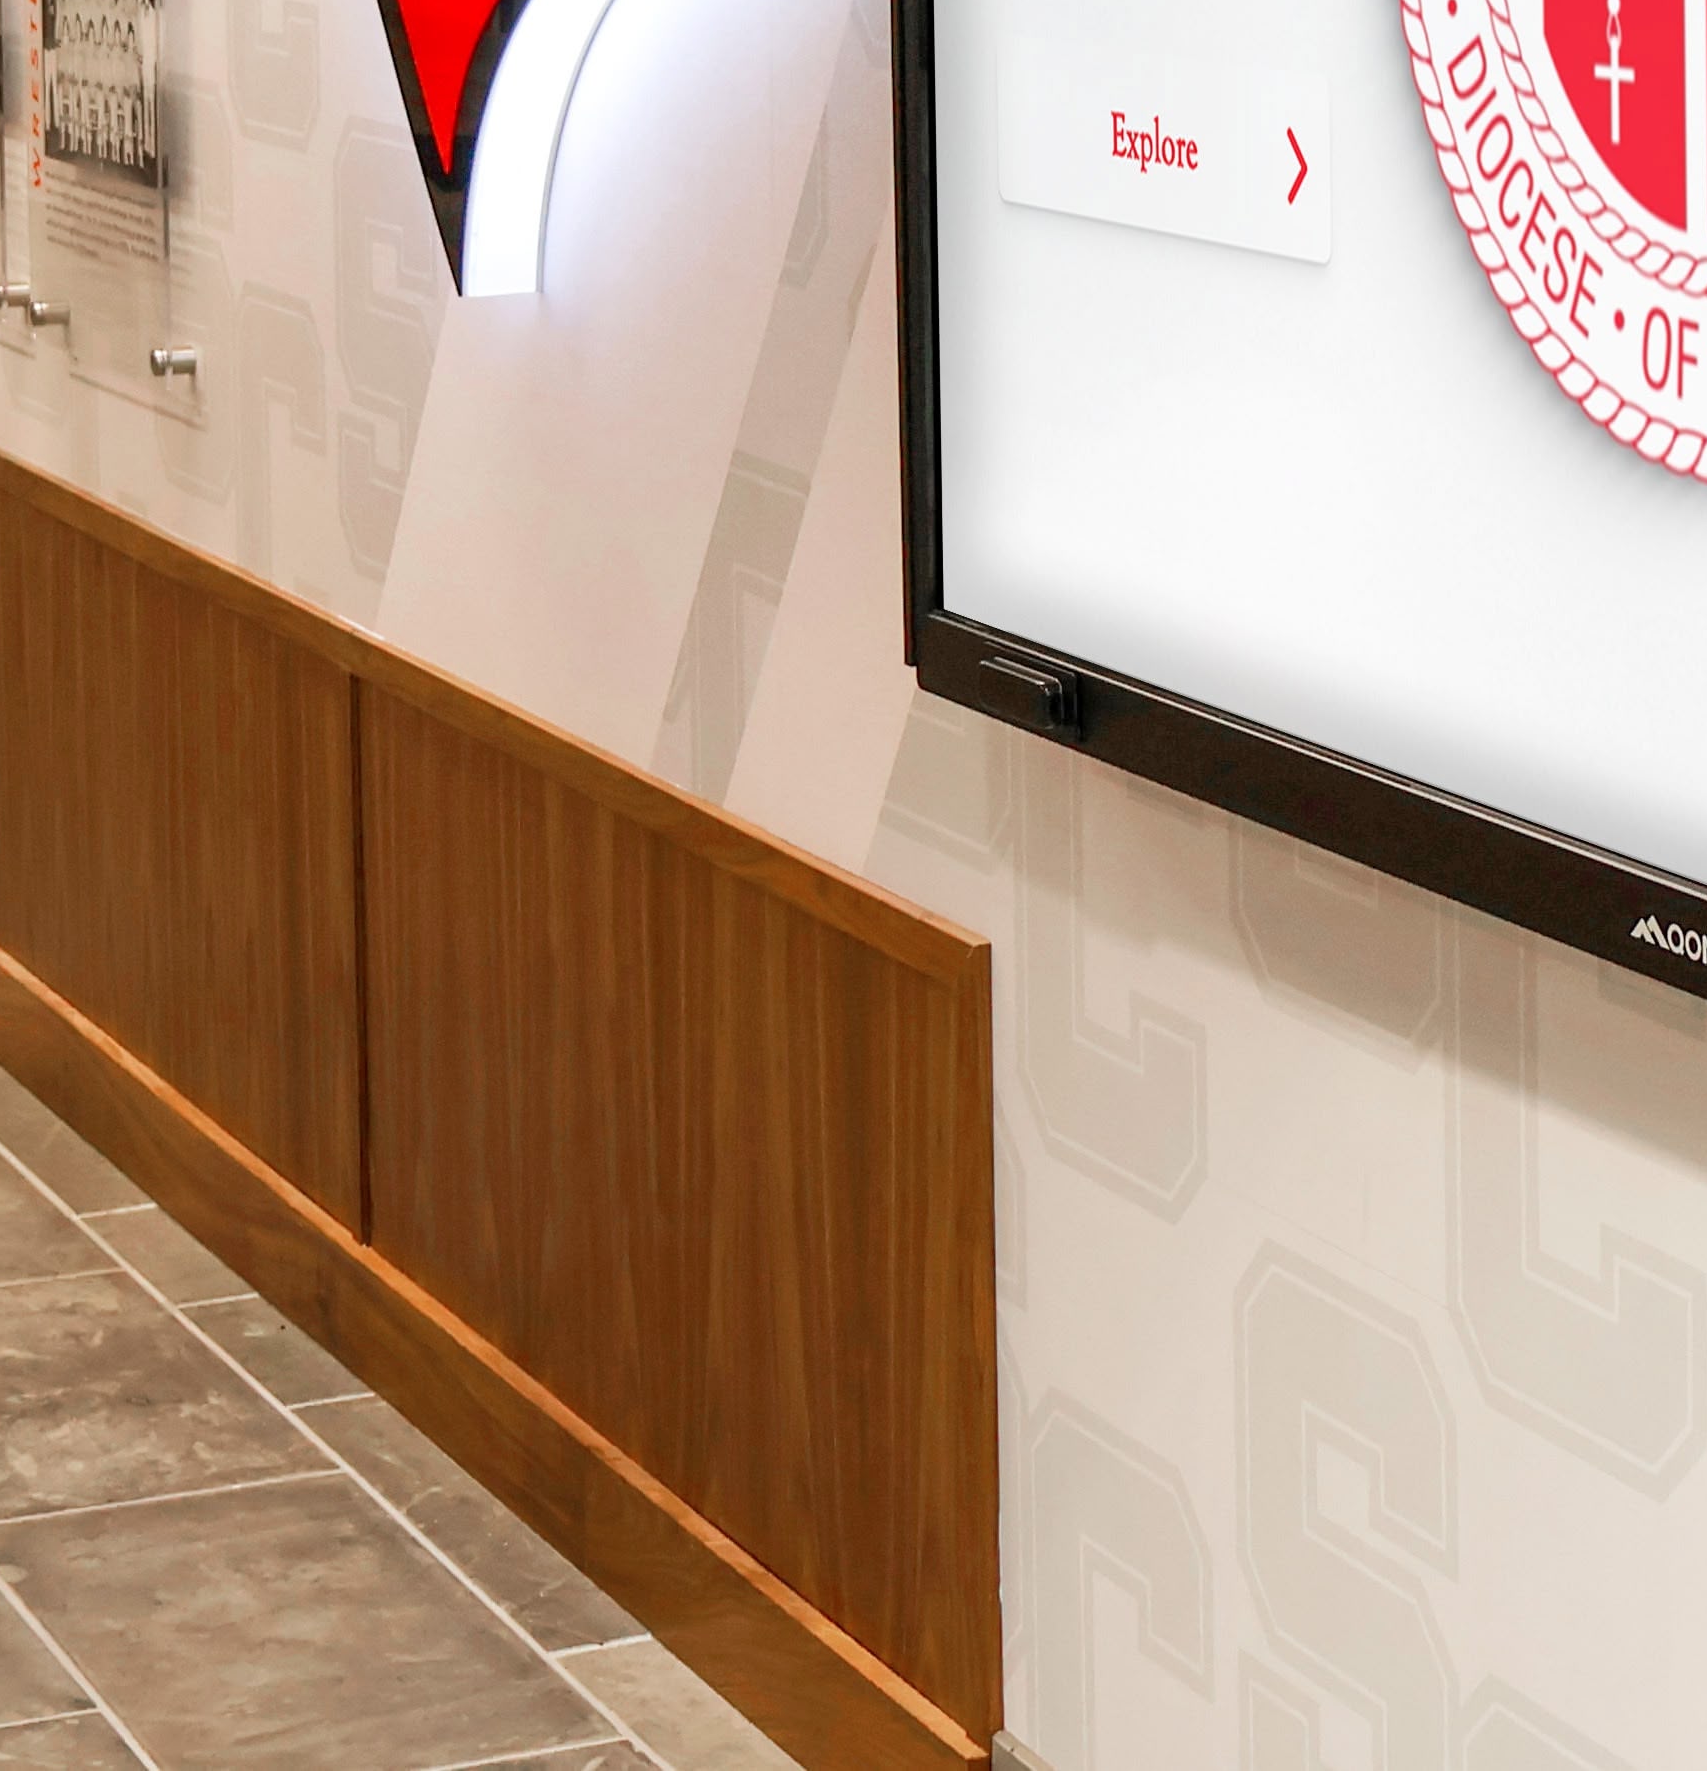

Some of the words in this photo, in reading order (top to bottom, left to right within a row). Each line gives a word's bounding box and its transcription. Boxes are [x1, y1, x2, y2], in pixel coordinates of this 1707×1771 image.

[1110, 110, 1199, 174] Explore
[1447, 34, 1604, 338] DIOCESE
[1642, 306, 1700, 400] OF
